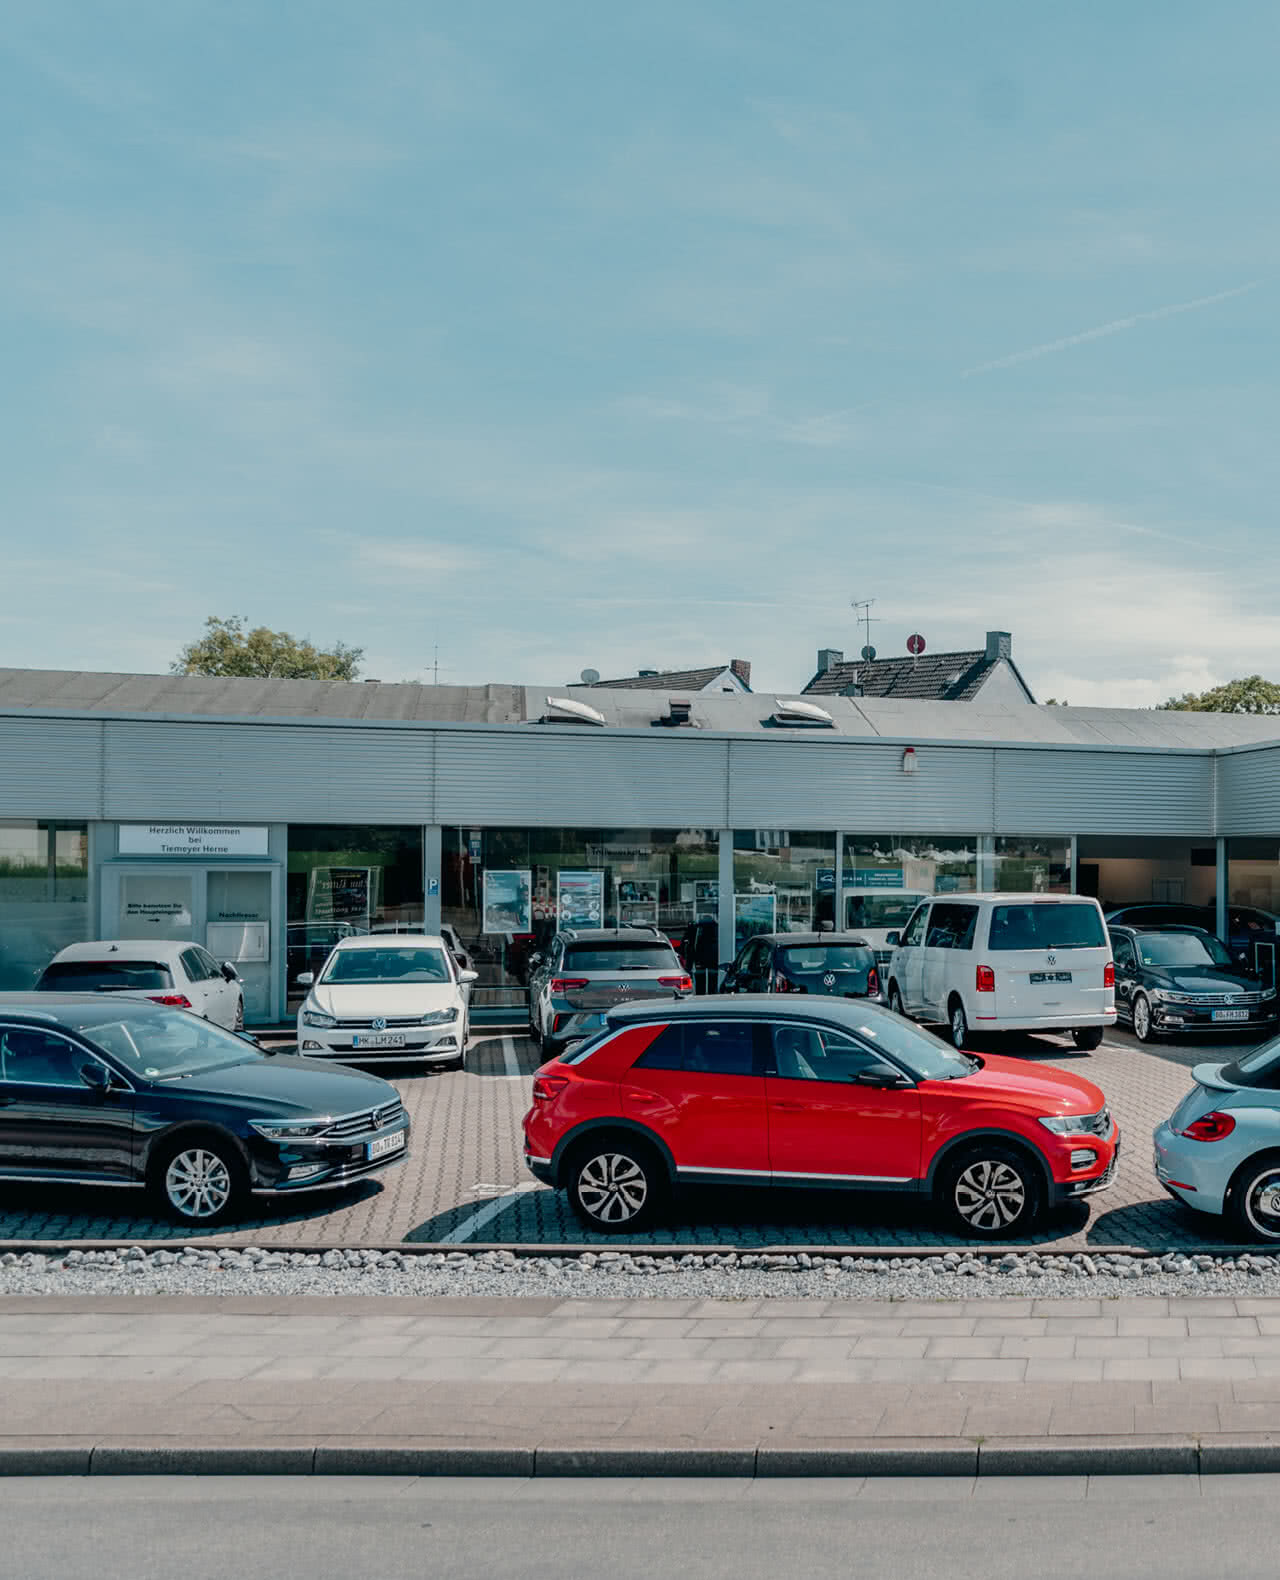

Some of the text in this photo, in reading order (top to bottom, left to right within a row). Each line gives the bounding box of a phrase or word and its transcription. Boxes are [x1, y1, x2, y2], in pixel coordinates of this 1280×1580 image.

[149, 826, 241, 836] Herzlich Willkommen
[161, 844, 229, 855] Tiemeyer Herne
